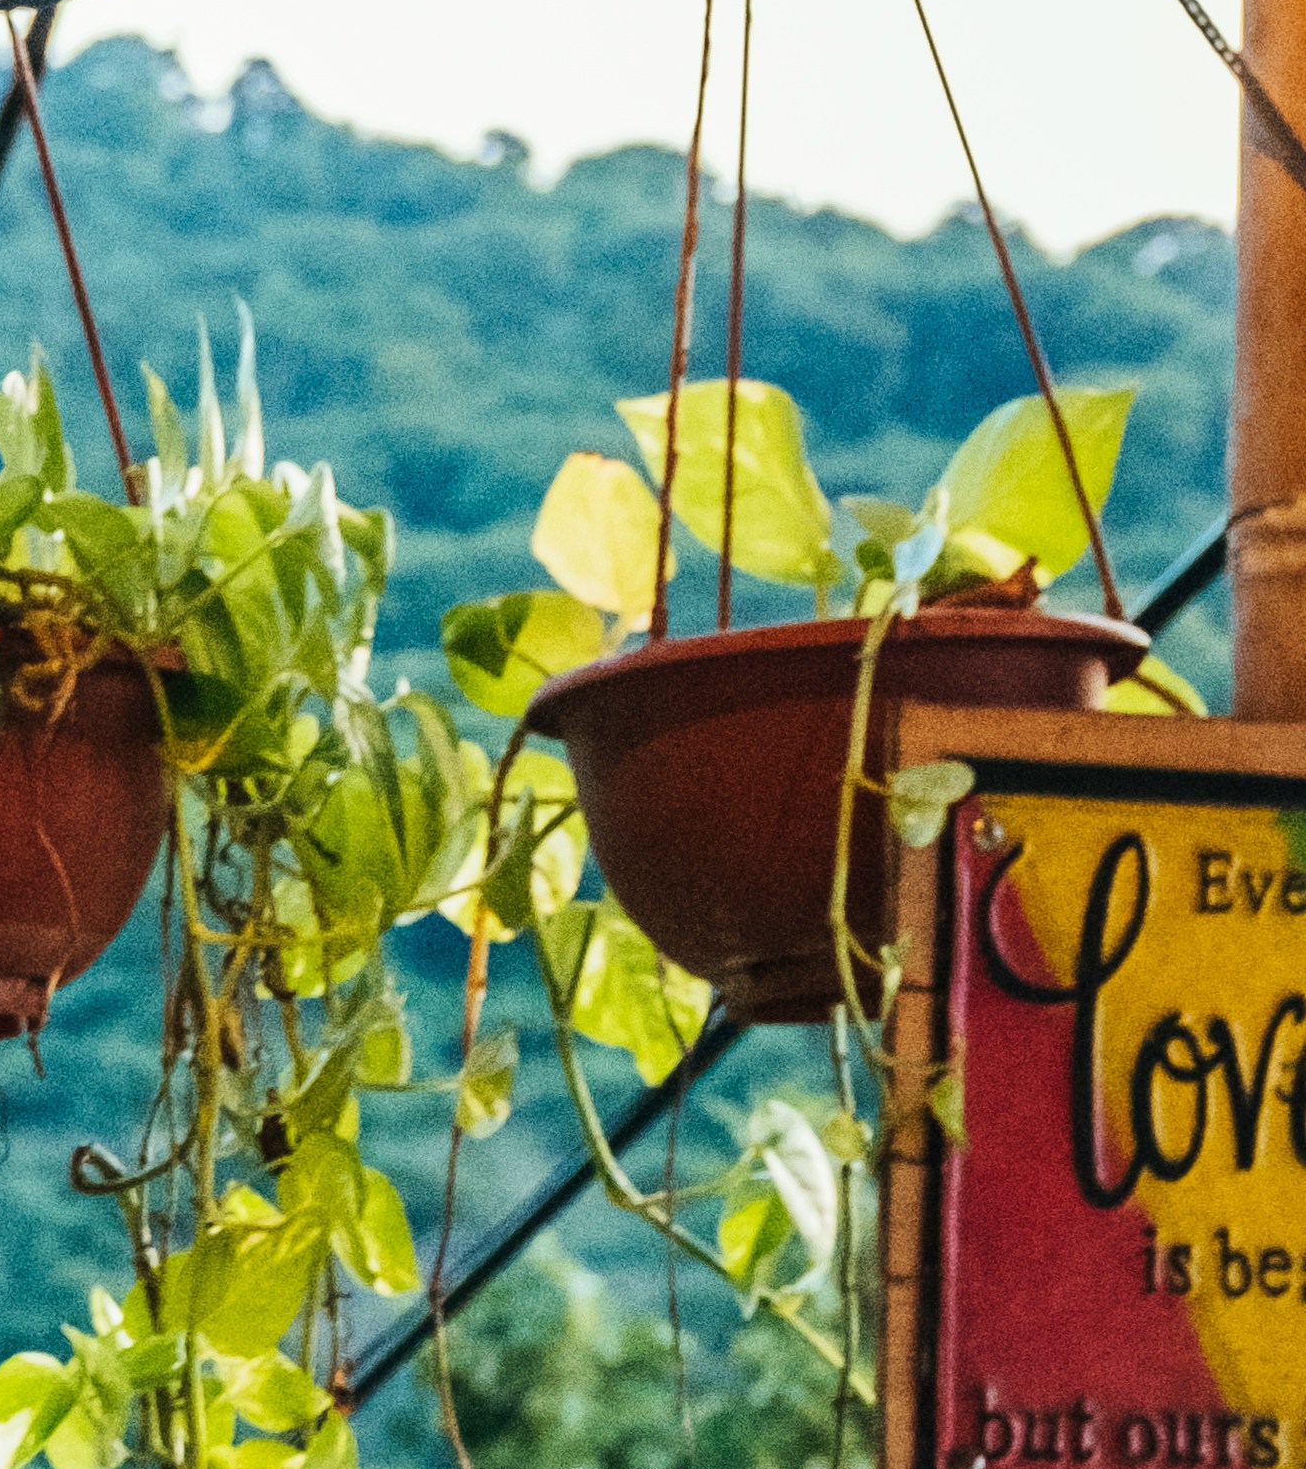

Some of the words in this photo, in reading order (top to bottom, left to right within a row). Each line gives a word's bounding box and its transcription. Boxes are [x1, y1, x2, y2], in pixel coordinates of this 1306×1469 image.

[984, 832, 1306, 1208] Lov
[1142, 1224, 1190, 1296] is
[1214, 1227, 1306, 1304] be
[976, 1384, 1093, 1462] but
[1115, 1408, 1280, 1467] ours
